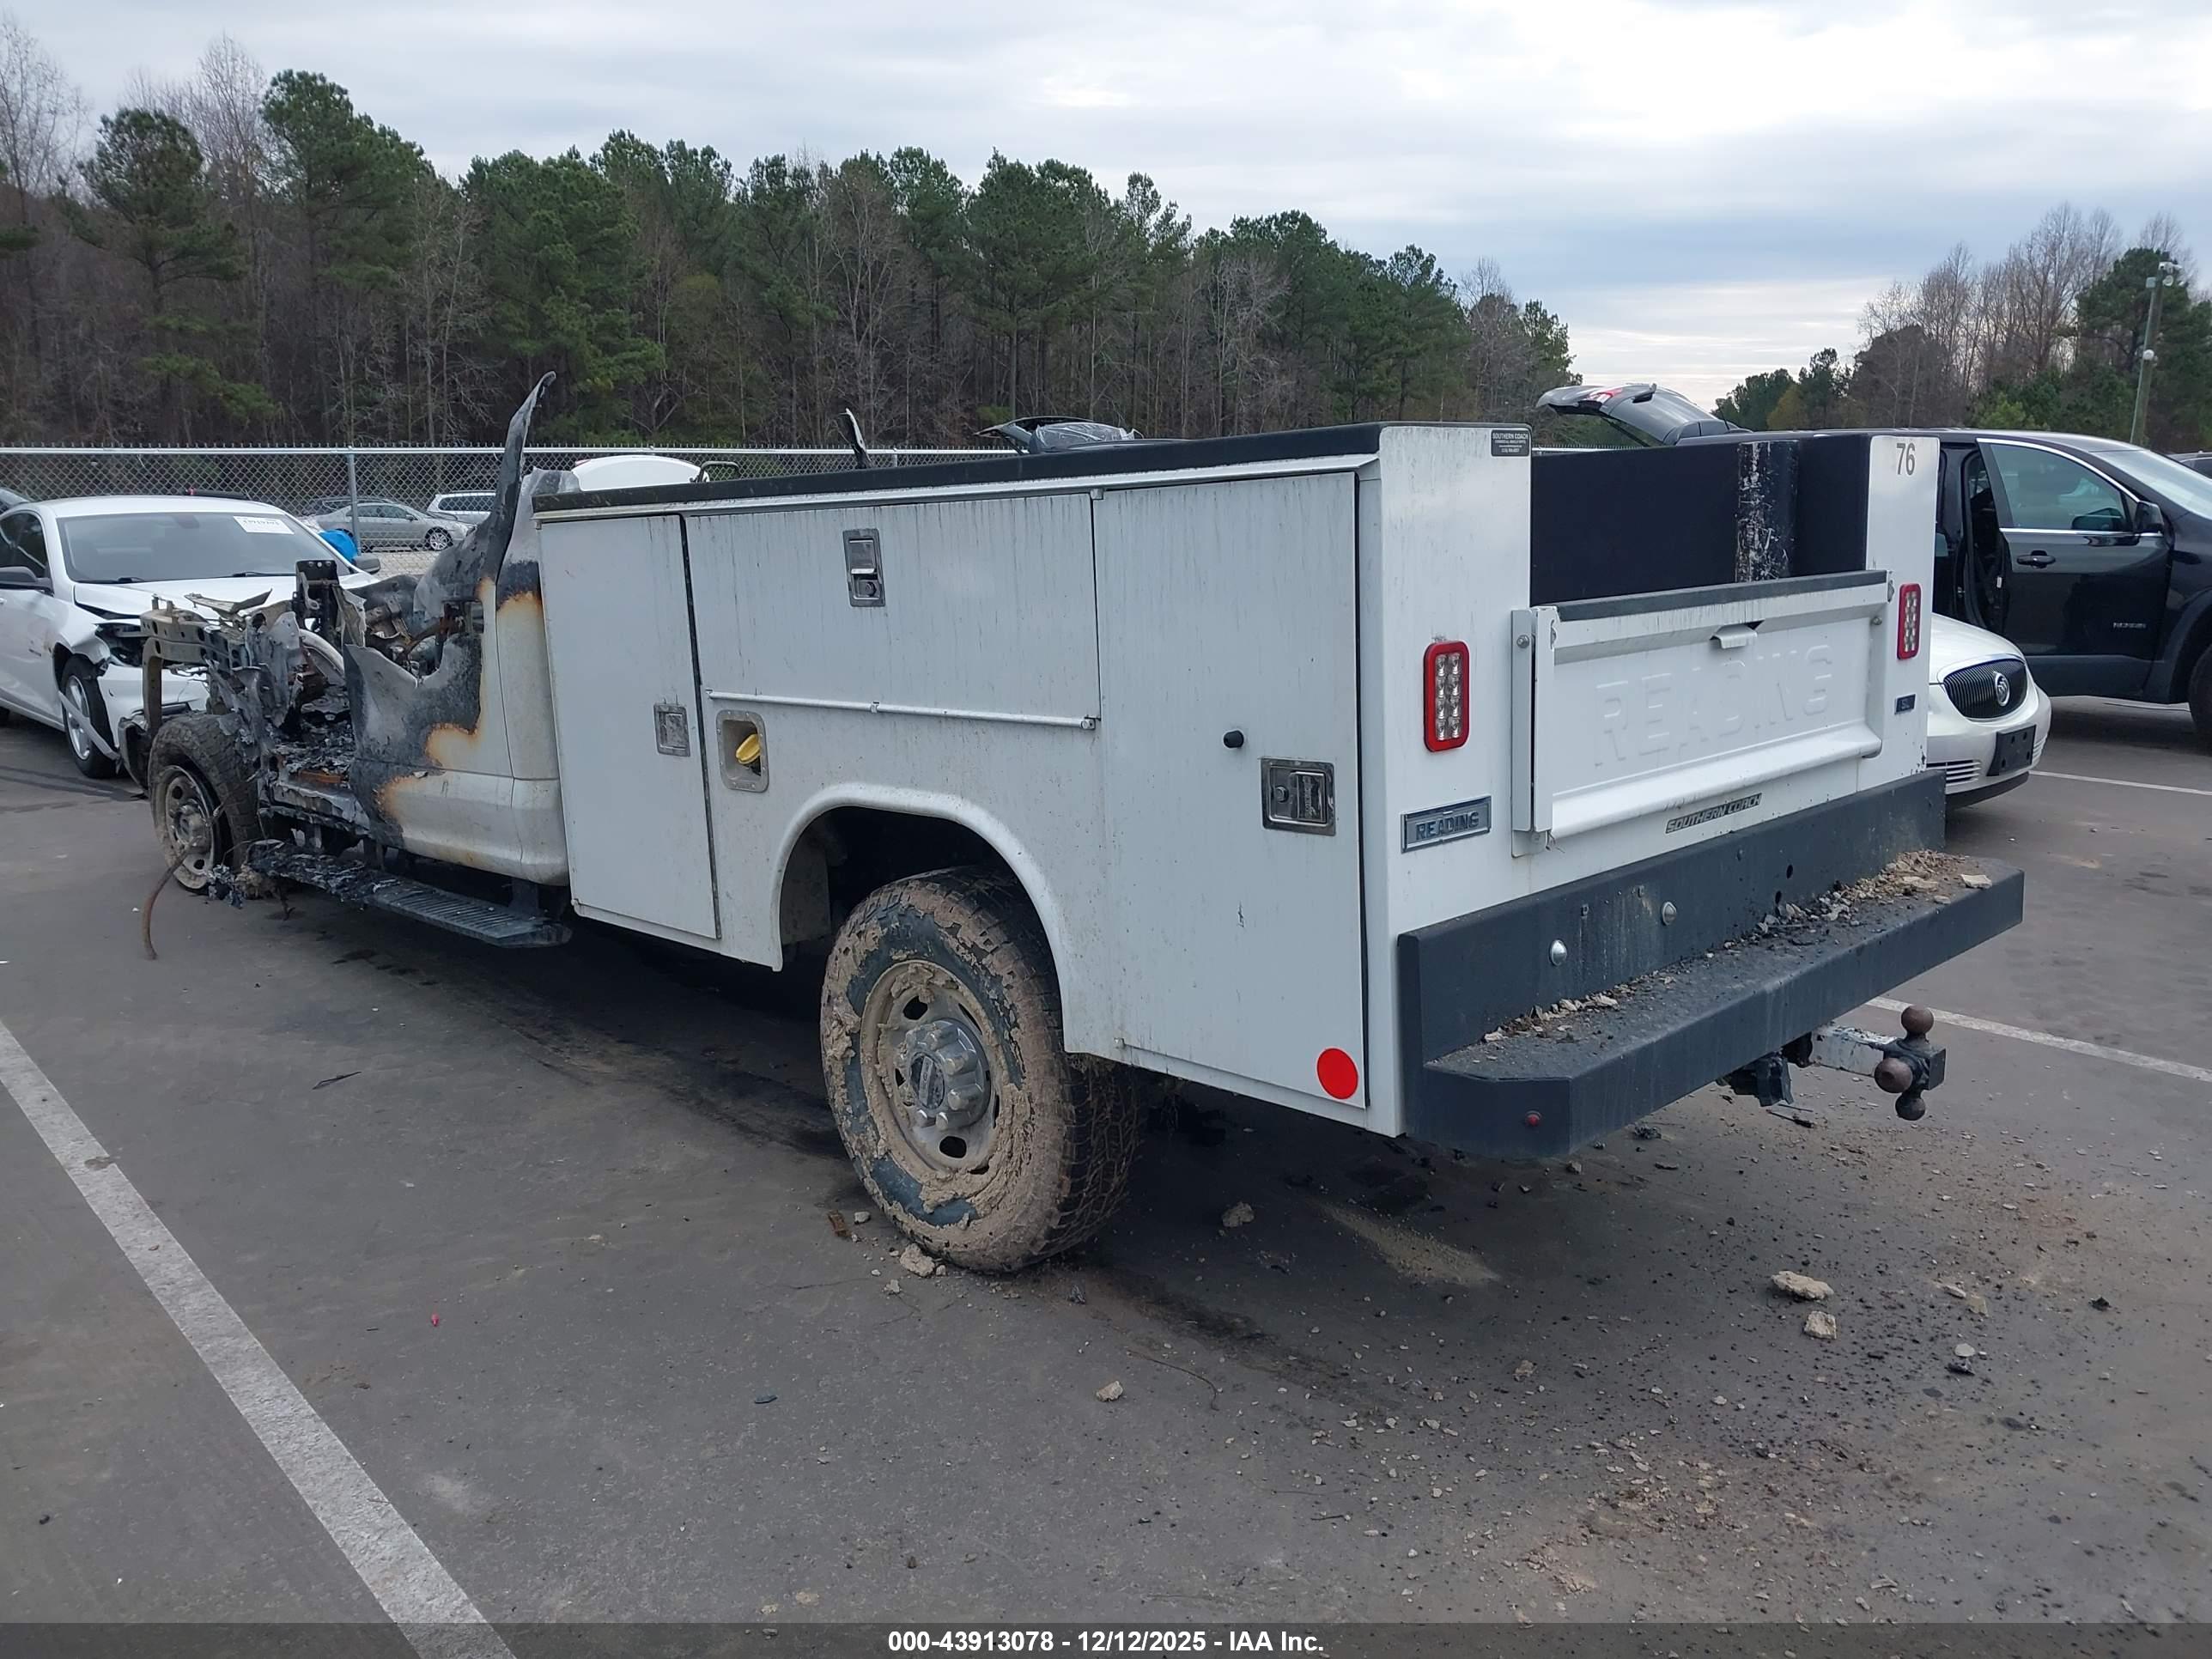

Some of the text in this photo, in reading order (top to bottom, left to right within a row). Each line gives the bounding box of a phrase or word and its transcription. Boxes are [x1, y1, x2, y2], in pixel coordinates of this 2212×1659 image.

[1896, 442, 1916, 476] 76
[1415, 810, 1480, 842] READING
[1666, 793, 1762, 833] SOUTHERN COACH
